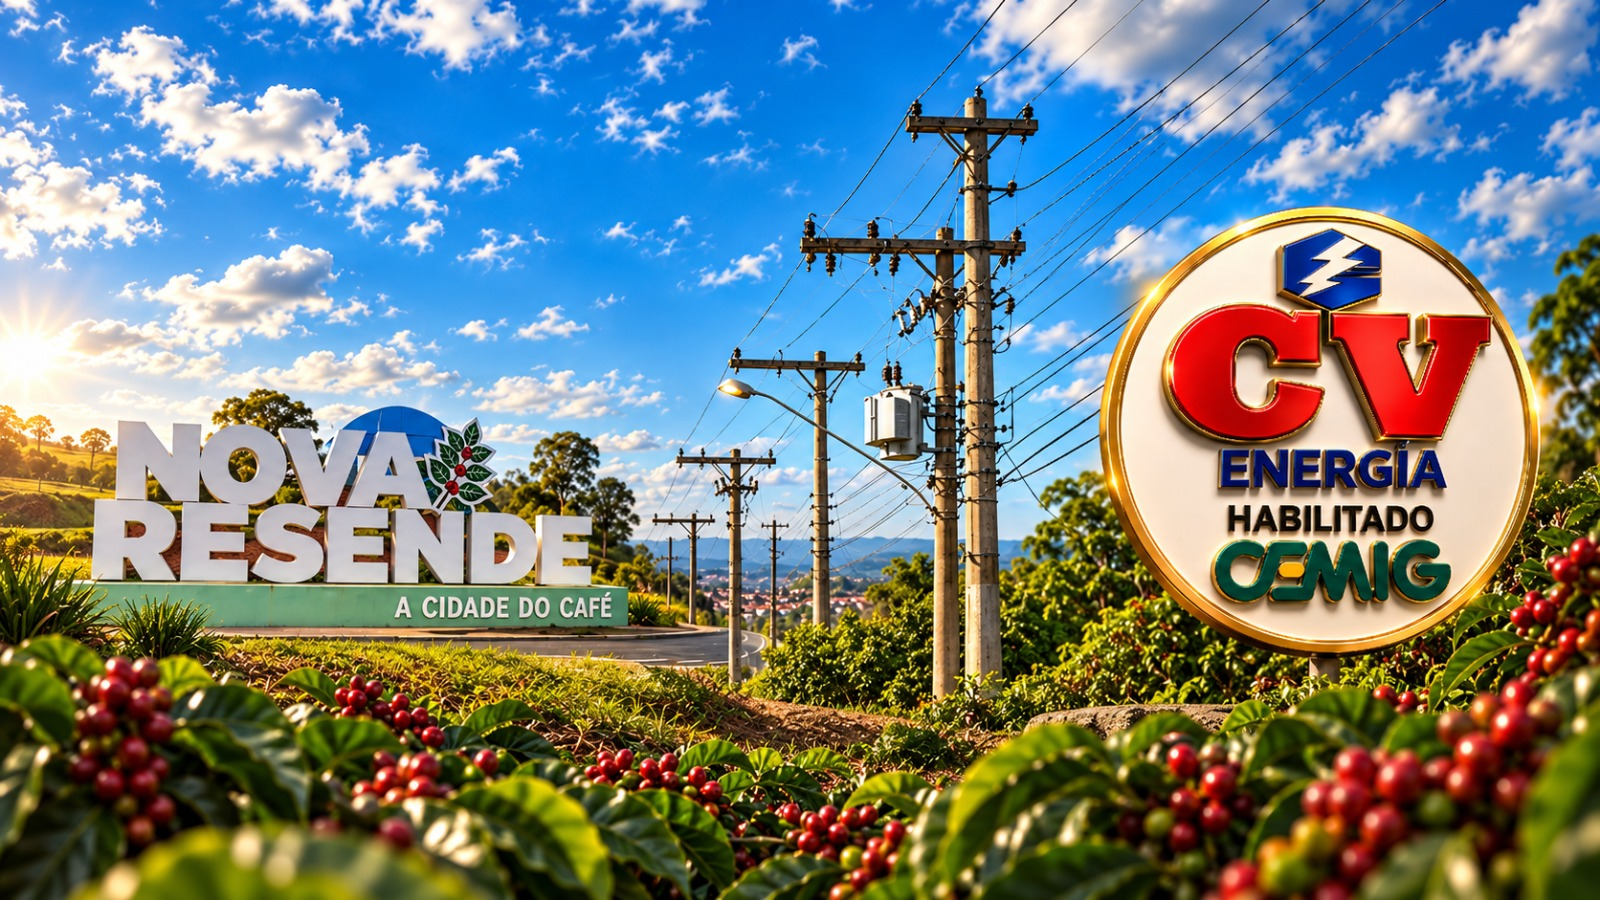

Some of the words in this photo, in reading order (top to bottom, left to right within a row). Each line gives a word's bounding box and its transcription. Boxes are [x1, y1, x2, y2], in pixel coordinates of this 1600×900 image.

[1163, 303, 1493, 443] CV
[115, 420, 437, 509] NOVA
[91, 499, 593, 585] RESENDE
[1227, 504, 1434, 533] HABILITADO
[395, 597, 412, 619] A
[421, 596, 510, 619] CIDADE
[518, 596, 551, 619] DO
[559, 591, 613, 619] CAFÉ
[1212, 540, 1452, 602] CEMIG
